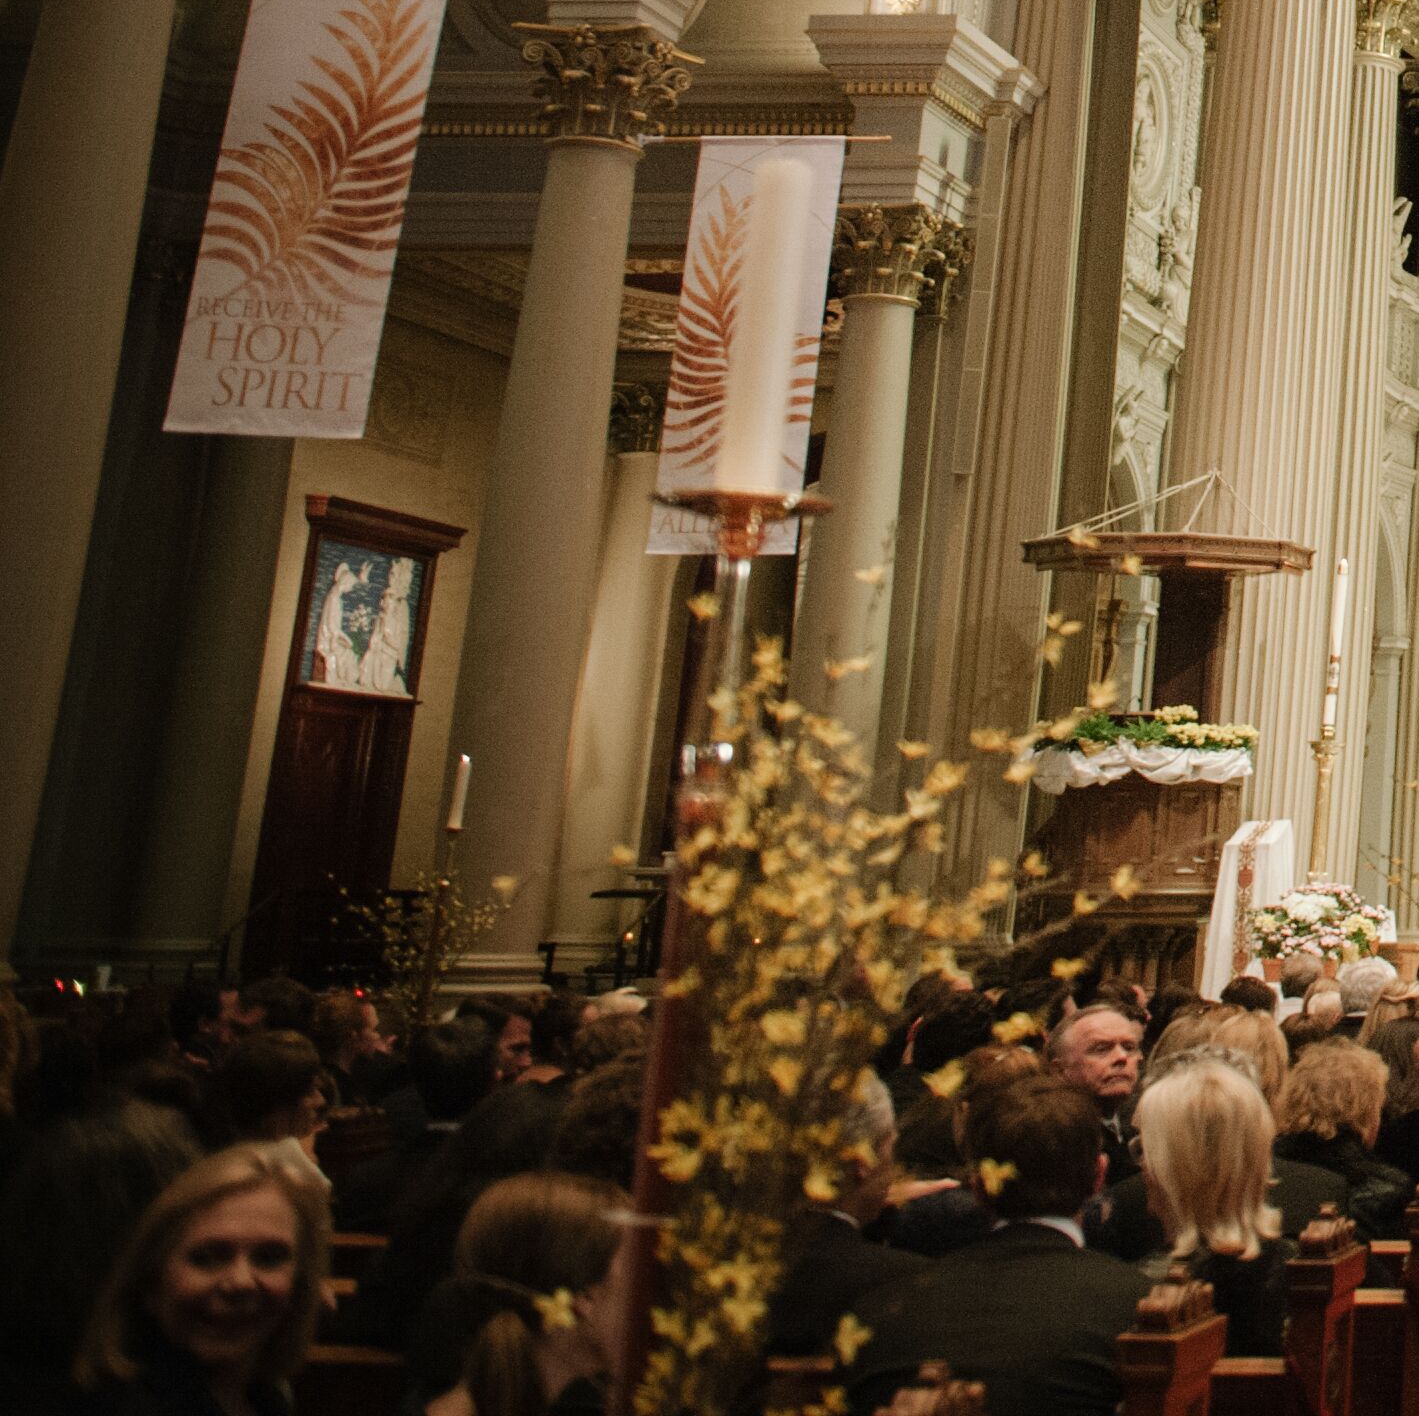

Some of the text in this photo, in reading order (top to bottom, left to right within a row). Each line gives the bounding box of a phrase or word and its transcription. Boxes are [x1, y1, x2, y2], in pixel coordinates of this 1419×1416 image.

[197, 296, 347, 323] RECEIVE THE
[205, 321, 343, 366] HOLY
[211, 365, 363, 412] SPIRIT
